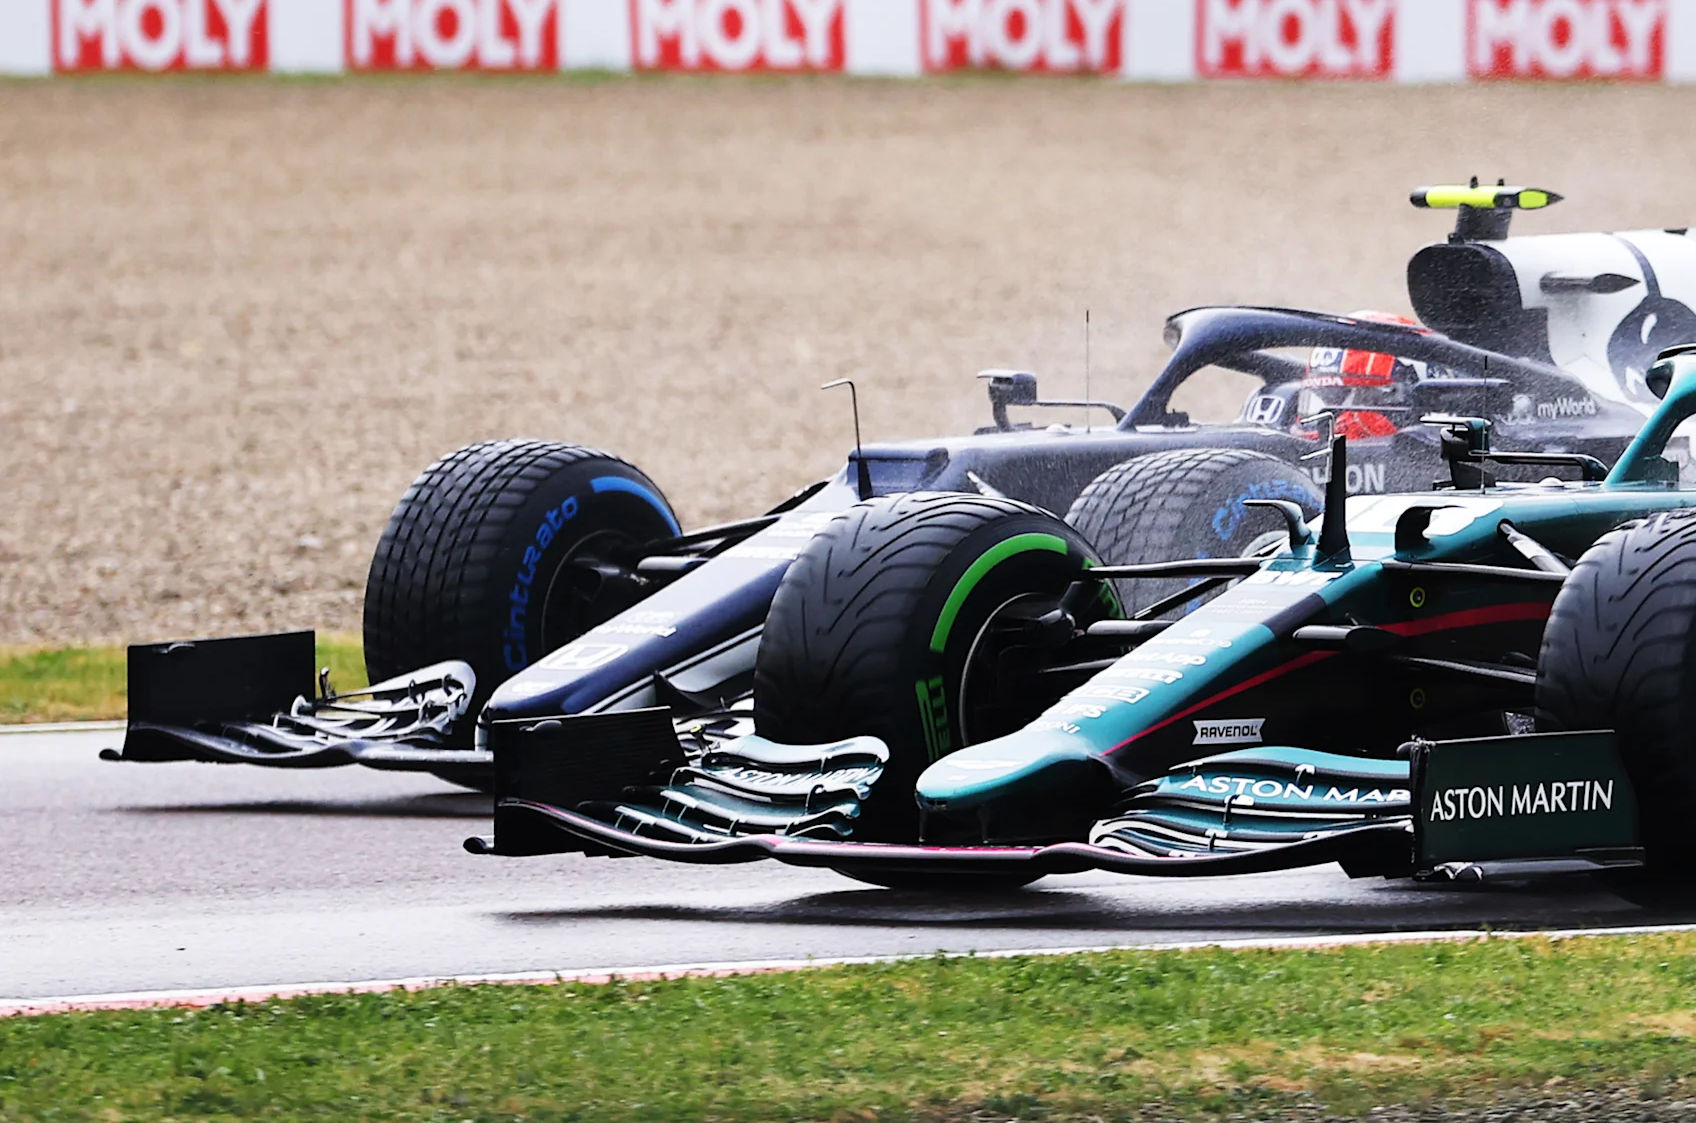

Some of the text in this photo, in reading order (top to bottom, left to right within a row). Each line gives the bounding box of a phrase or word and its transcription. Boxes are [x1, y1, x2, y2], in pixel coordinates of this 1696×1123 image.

[1537, 397, 1598, 419] myWorld
[1200, 724, 1258, 739] RAVENOL
[1180, 774, 1411, 802] ASTON MAR
[1430, 779, 1614, 822] ASTON MARTIN
